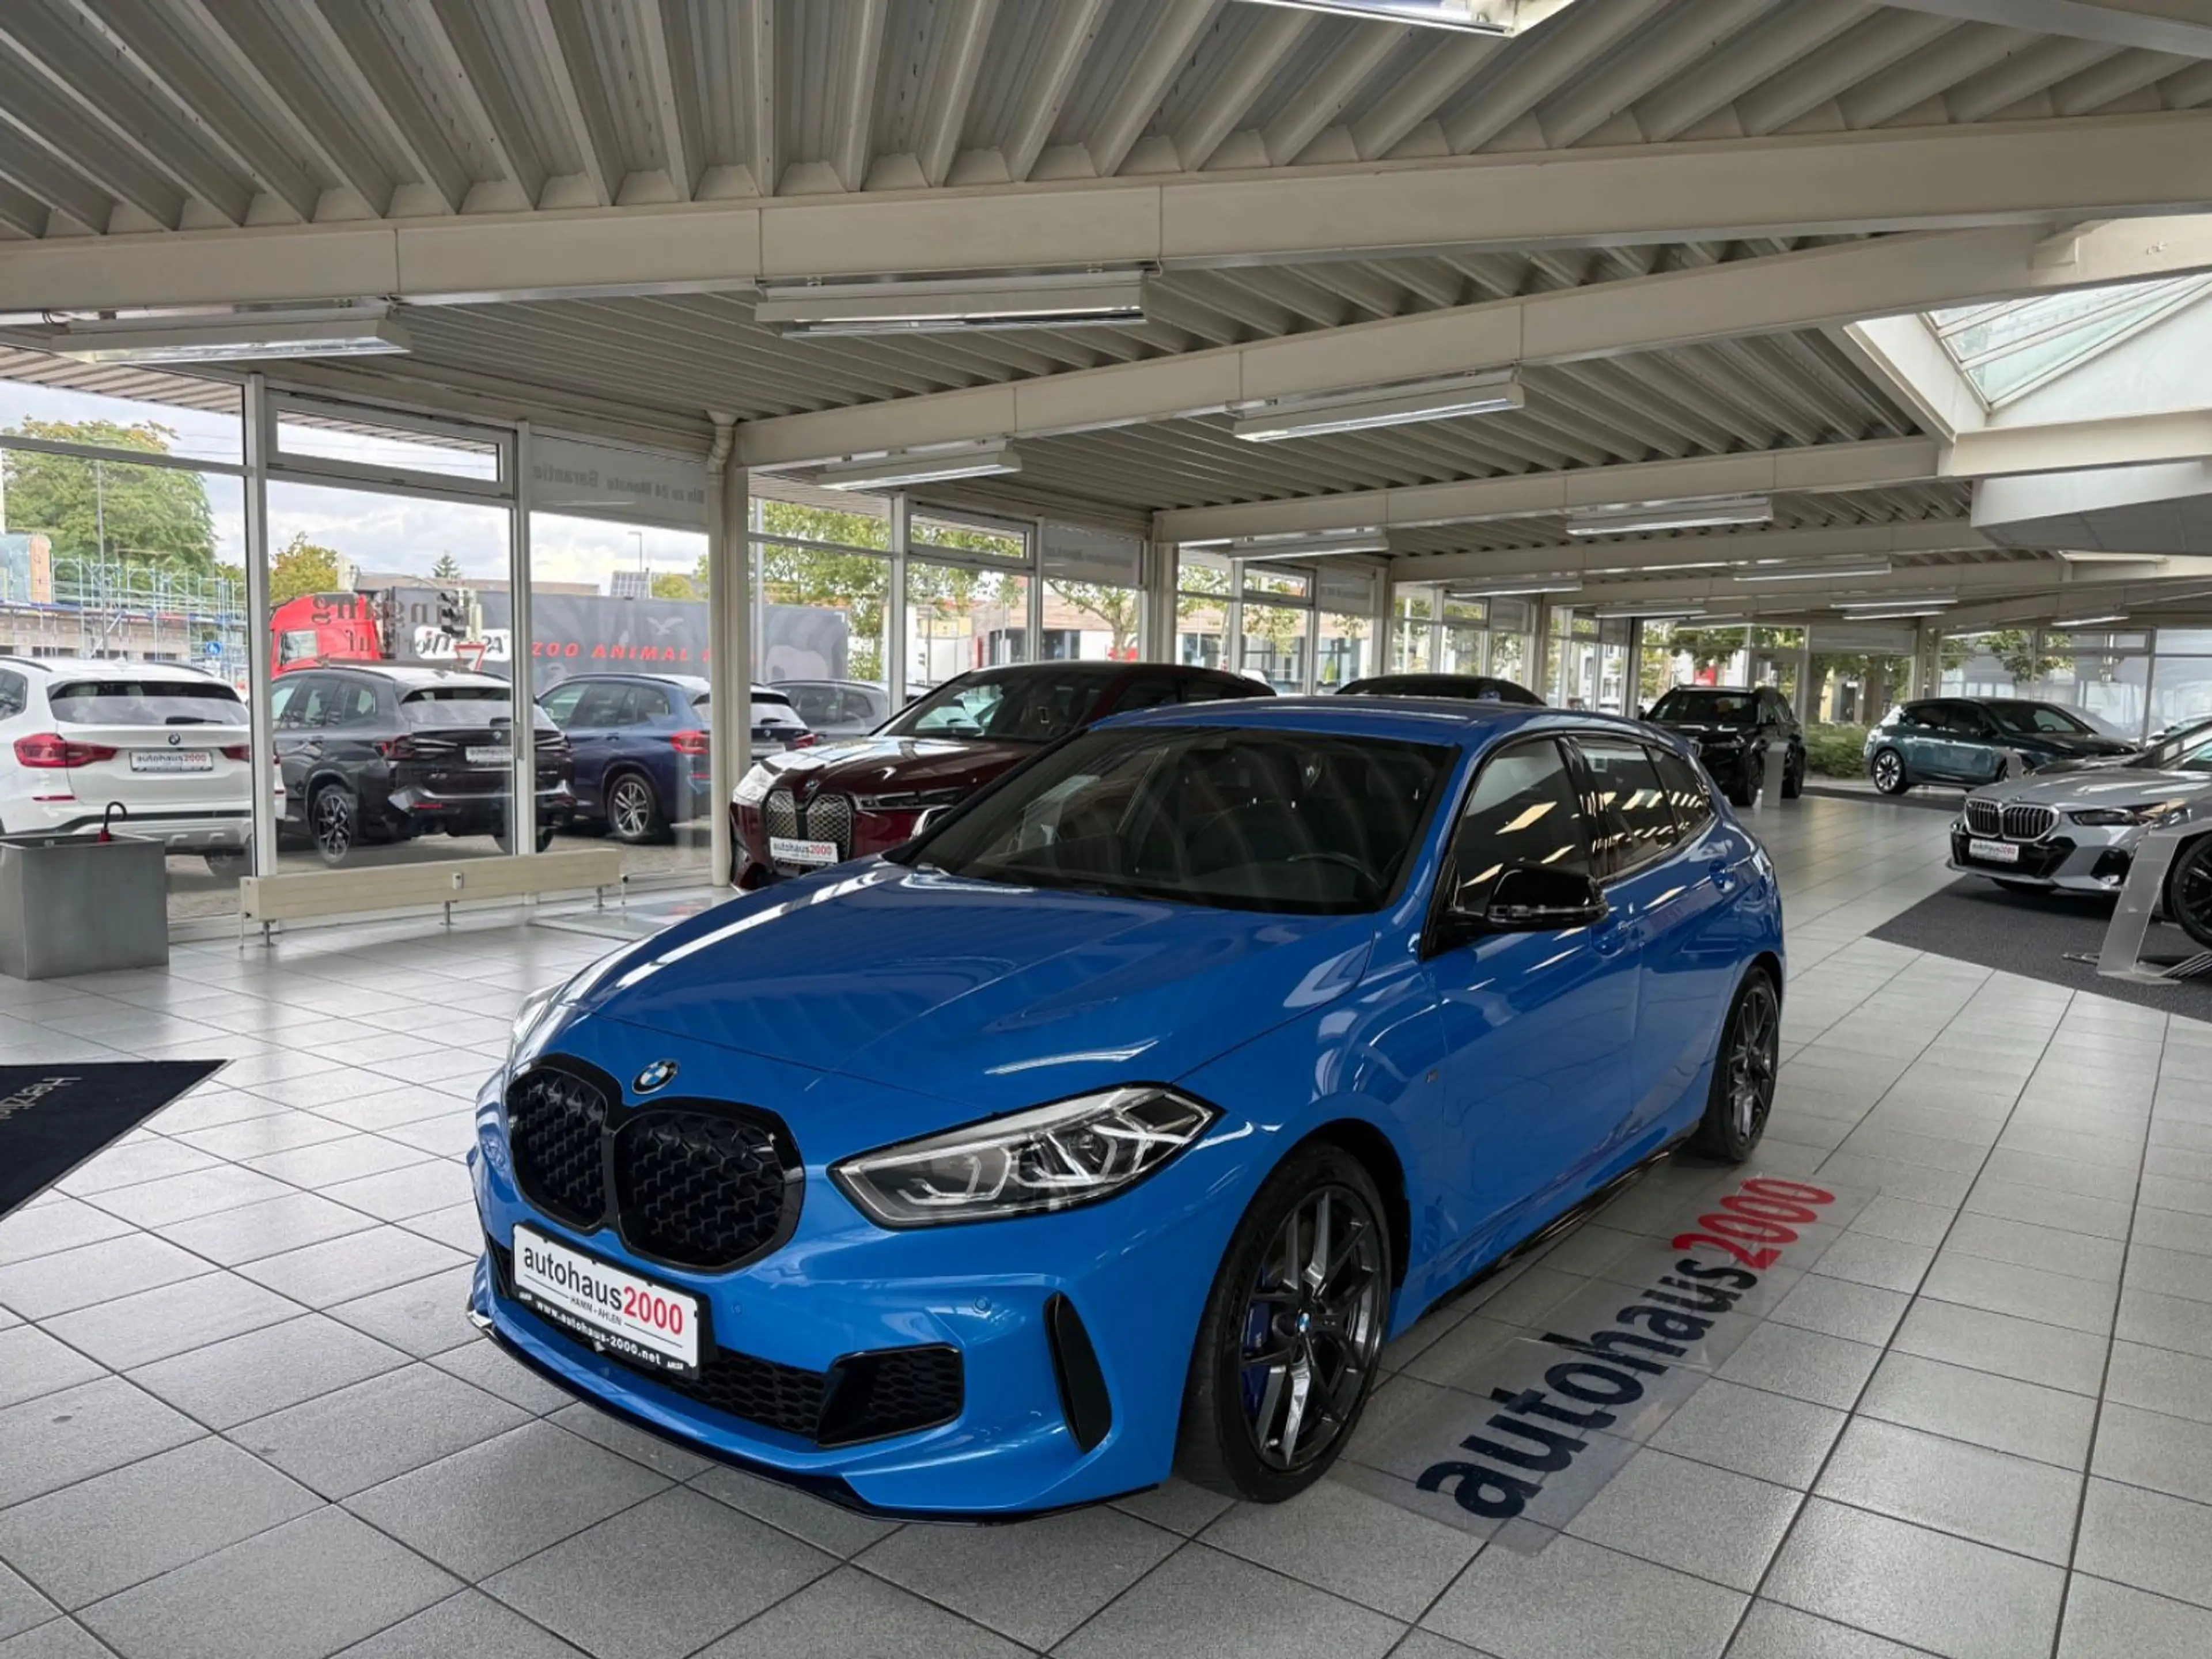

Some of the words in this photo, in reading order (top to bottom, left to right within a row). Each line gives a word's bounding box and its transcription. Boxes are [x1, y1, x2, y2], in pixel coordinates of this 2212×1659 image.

[531, 642, 580, 658] ZOO
[590, 643, 690, 662] ANIMAL
[524, 1247, 683, 1335] autohaus2000
[570, 1296, 593, 1313] HAMM
[535, 1301, 662, 1366] www.autohaus-2000.net
[1416, 1178, 1835, 1518] autohaus2000
